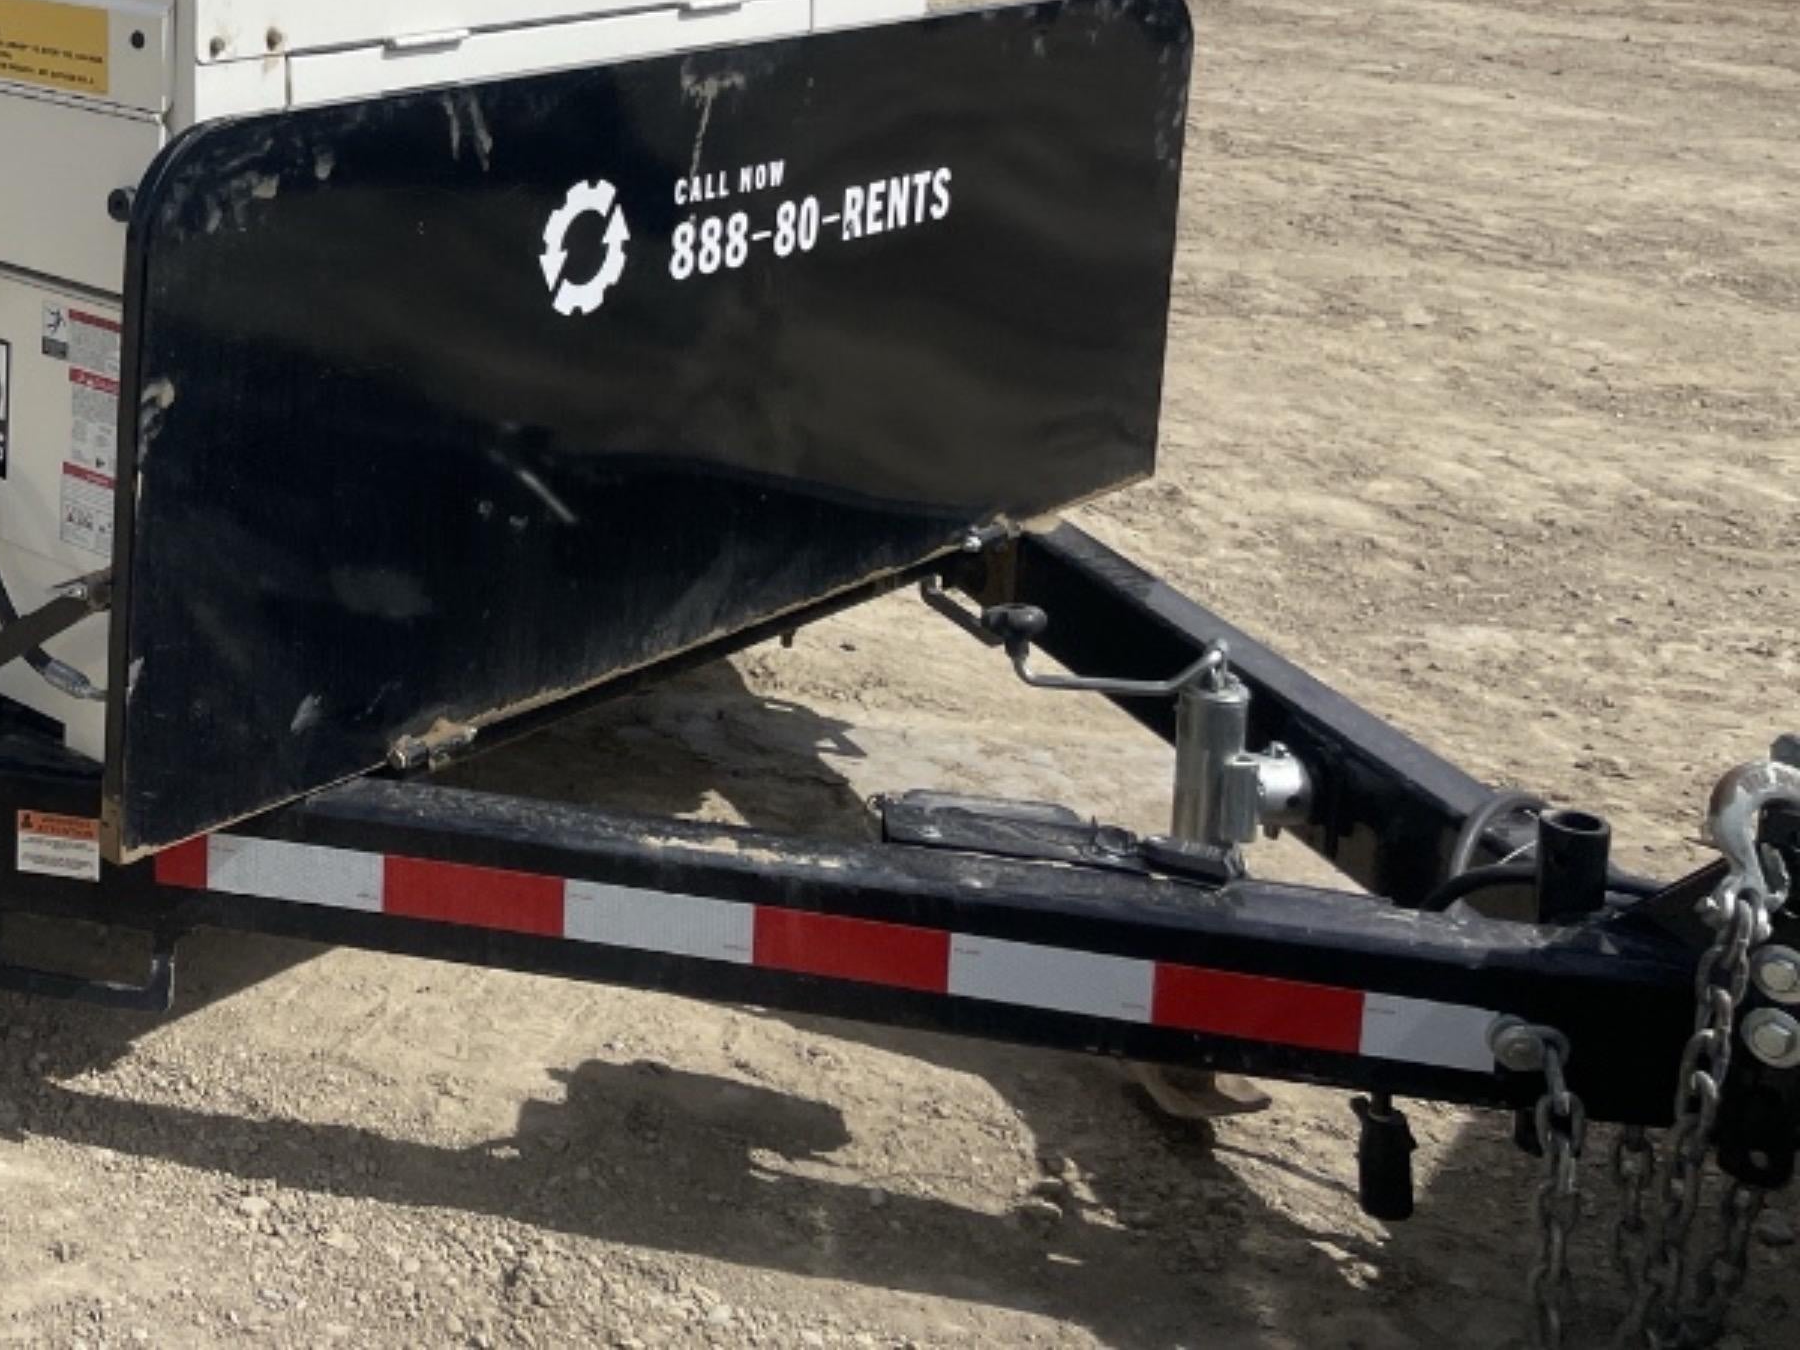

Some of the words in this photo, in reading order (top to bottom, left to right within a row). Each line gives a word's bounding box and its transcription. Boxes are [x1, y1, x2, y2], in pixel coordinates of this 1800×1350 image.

[673, 169, 730, 206] CALL
[737, 158, 786, 194] NOW
[668, 166, 953, 281] 888-80-RENTS
